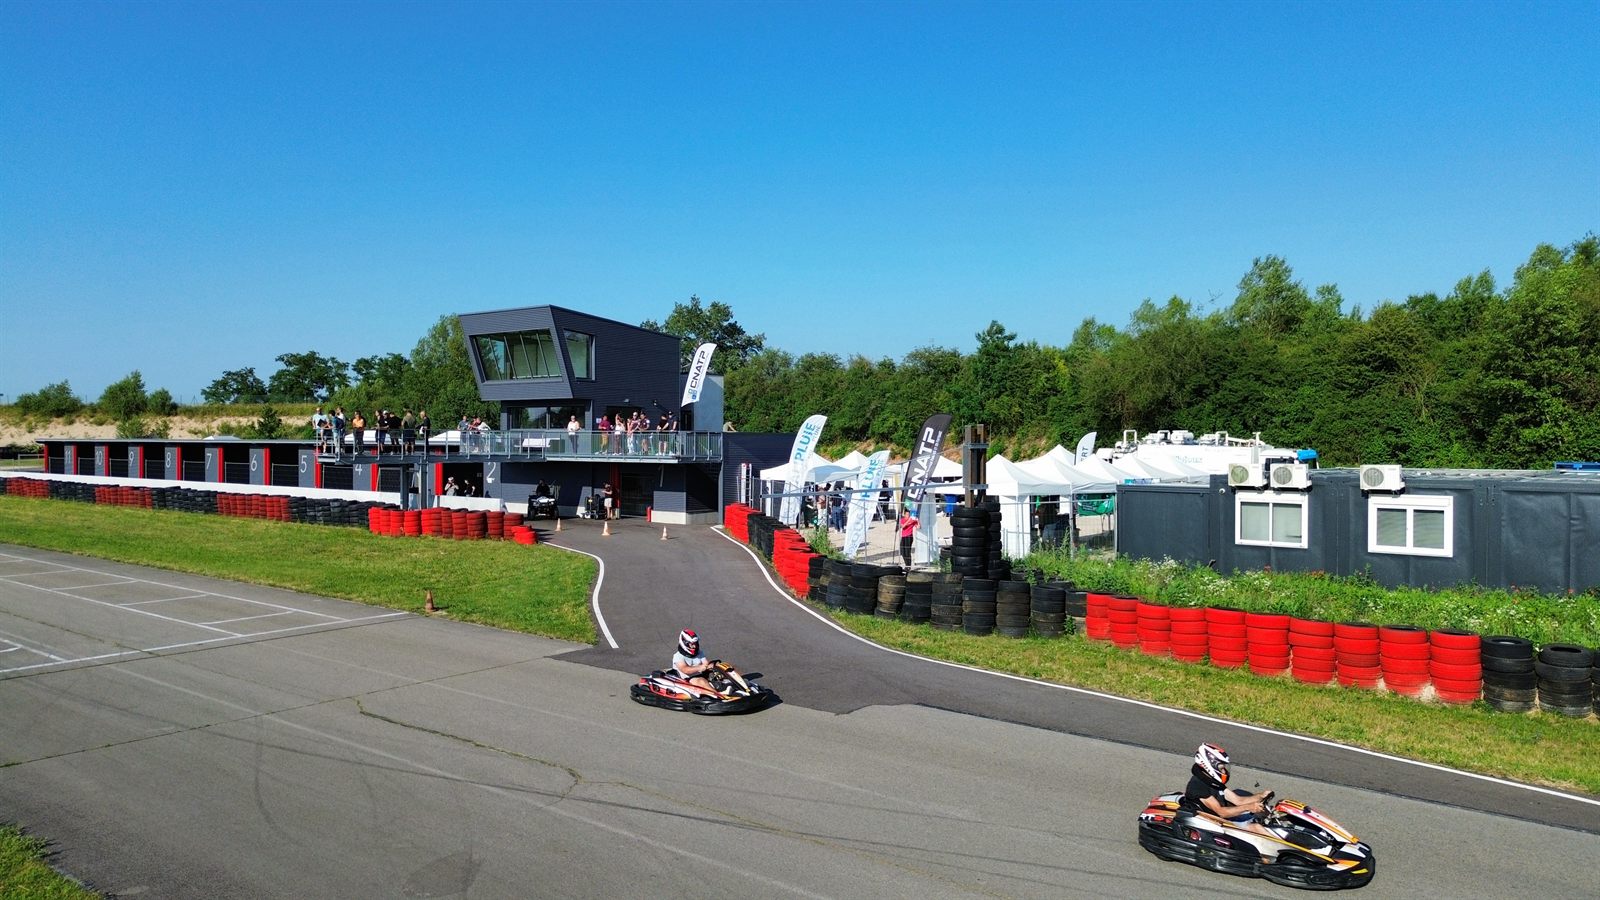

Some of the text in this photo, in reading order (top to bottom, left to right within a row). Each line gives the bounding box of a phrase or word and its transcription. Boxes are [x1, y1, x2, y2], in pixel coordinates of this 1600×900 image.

[690, 350, 705, 389] CNATP
[794, 422, 815, 461] PLUIE
[95, 450, 103, 466] 10
[128, 451, 135, 467] 9
[165, 452, 172, 468] 8
[206, 453, 212, 469] 7
[250, 454, 258, 471] 6
[300, 455, 308, 473] 5
[907, 427, 935, 499] CNATP
[354, 463, 363, 476] 4
[486, 461, 496, 483] 2
